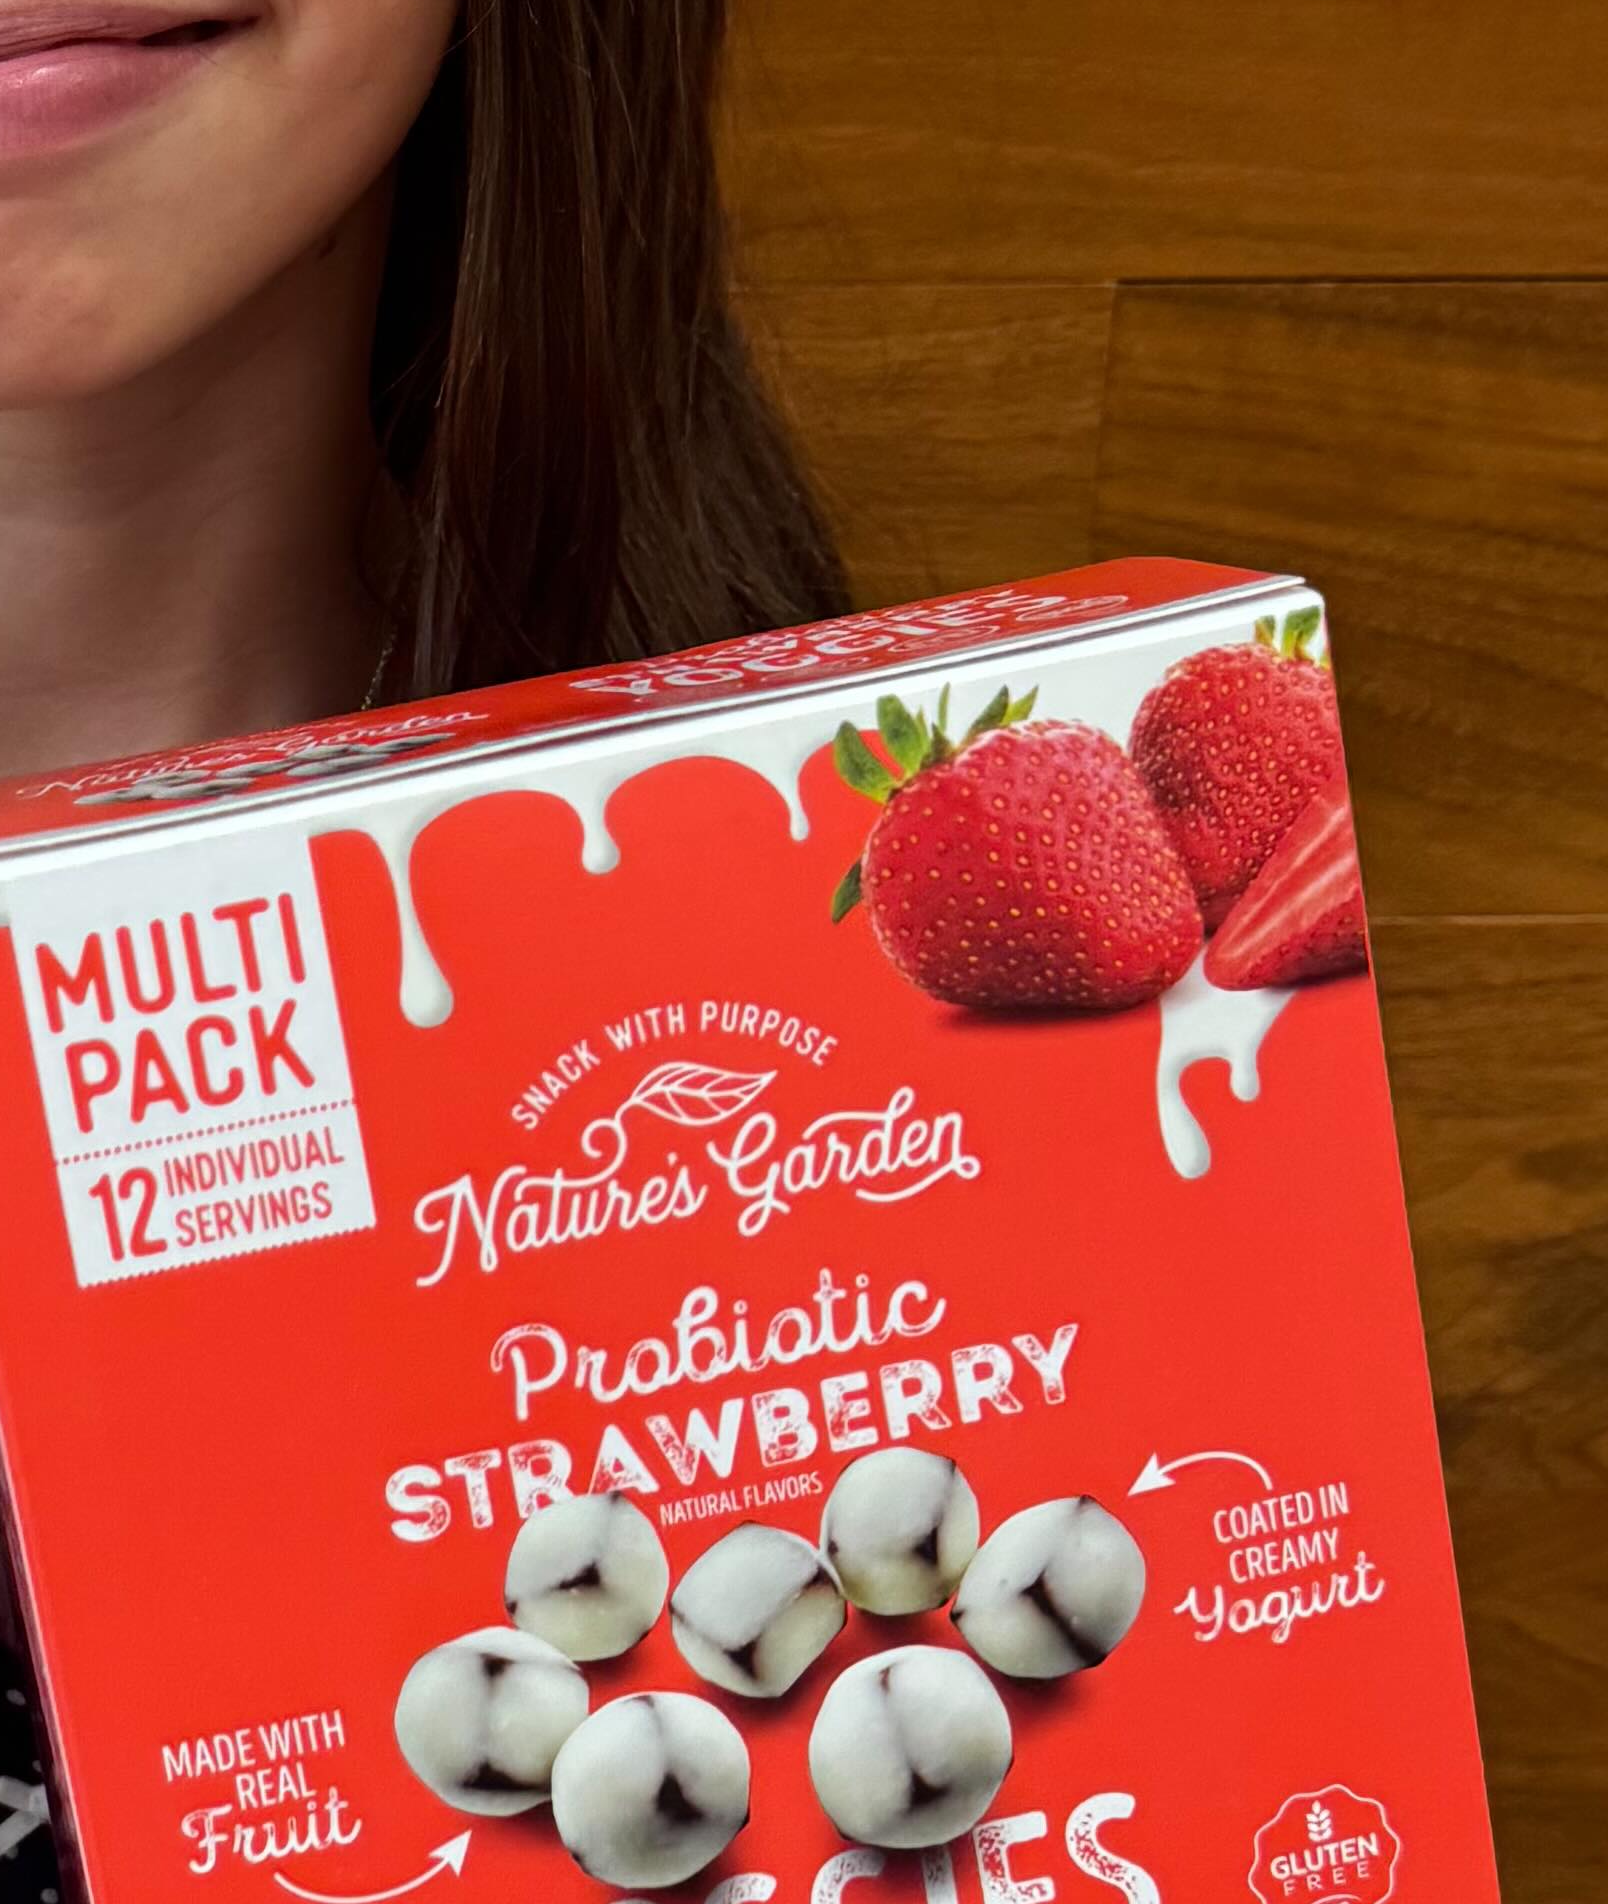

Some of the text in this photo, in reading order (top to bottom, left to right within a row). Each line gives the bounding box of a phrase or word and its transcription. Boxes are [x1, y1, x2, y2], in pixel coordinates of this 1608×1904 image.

[34, 892, 306, 1034] MULTI
[64, 998, 316, 1134] PACK
[510, 999, 839, 1132] SNACK WITH PURPOSE
[88, 1125, 346, 1263] 12 INDIVIDUAL
[174, 1181, 334, 1248] SERVINGS
[413, 1085, 981, 1288] Nature's Garden
[490, 1268, 946, 1421] Probiotic
[384, 1322, 1079, 1543] STRAWBERRY
[658, 1471, 823, 1527] NATURAL FLAVORS
[1212, 1481, 1350, 1544] COATED IN
[1173, 1550, 1385, 1644] Yogurt
[1228, 1527, 1340, 1584] CREAMY
[161, 1709, 346, 1782] MADE WITH
[235, 1761, 317, 1811] REAL
[180, 1786, 363, 1874] Fruit
[1270, 1832, 1379, 1880] GLUTEN
[1283, 1860, 1370, 1897] FREE
